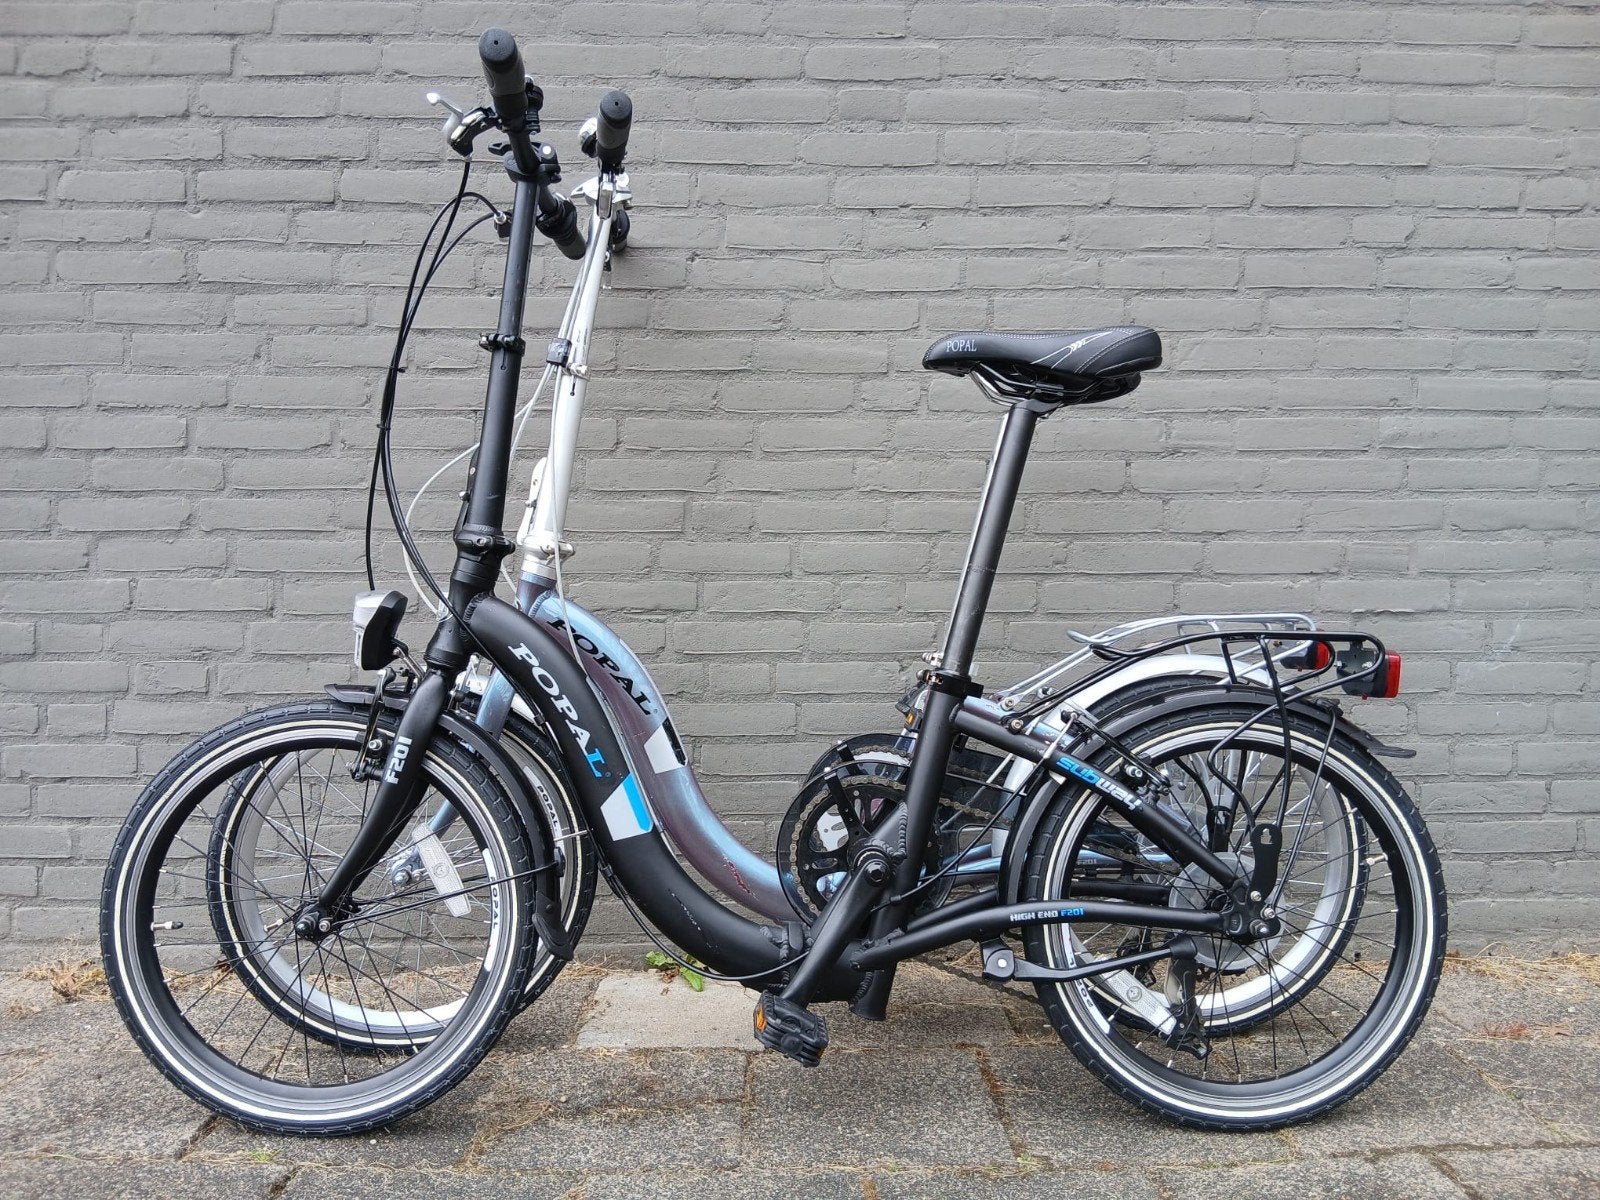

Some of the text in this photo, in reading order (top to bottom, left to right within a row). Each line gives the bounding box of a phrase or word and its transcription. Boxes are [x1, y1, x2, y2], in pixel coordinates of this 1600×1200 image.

[946, 339, 977, 352] POPAL
[547, 618, 651, 715] POPAL
[507, 642, 605, 778] POPAL
[385, 735, 413, 785] F201
[537, 785, 558, 828] POPAL
[1009, 907, 1085, 922] HIGH END F201
